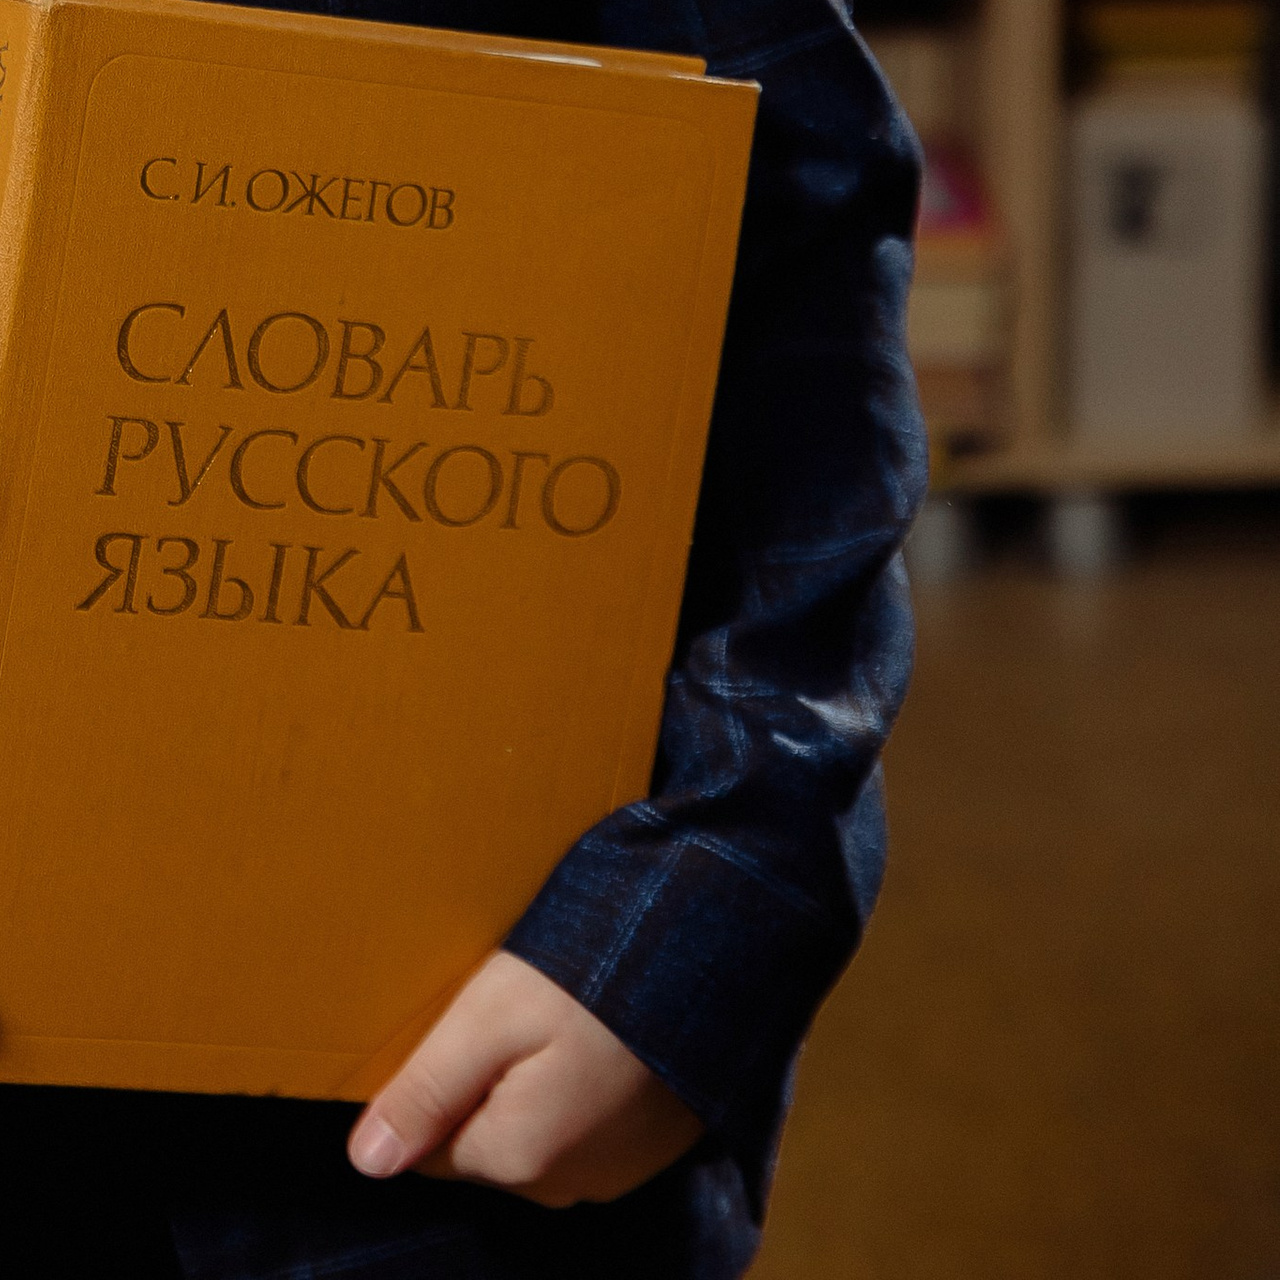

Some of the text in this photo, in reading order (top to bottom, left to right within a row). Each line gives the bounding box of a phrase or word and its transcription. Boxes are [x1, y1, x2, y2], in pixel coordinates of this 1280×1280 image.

[117, 302, 555, 418] СЛОВАРЬ
[94, 415, 621, 538] РУССКОГО
[74, 531, 426, 633] ЯЗЫКА
